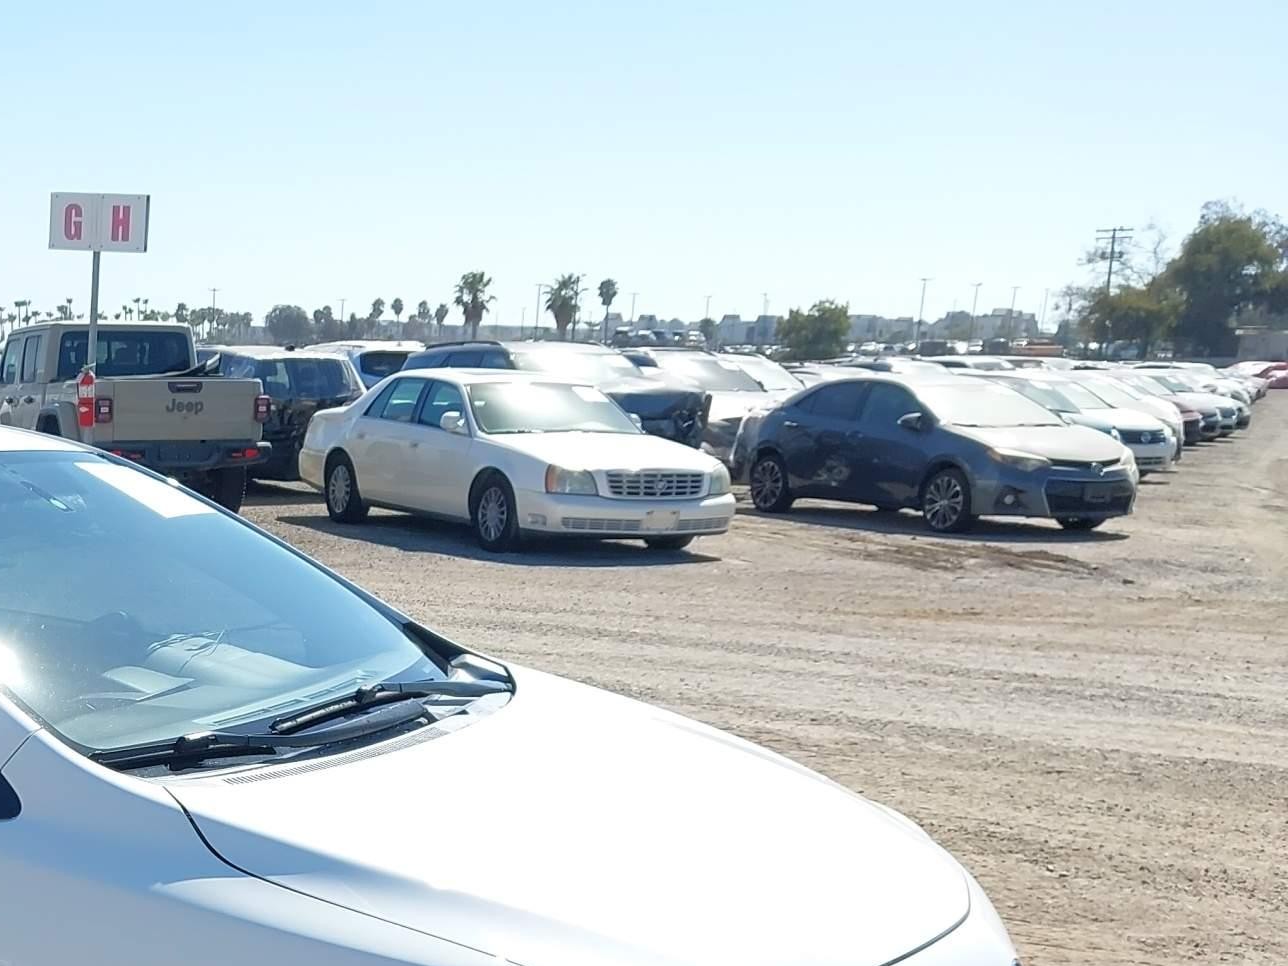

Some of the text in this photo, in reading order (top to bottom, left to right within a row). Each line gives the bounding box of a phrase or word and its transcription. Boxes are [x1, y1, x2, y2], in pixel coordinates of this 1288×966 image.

[64, 203, 131, 242] G H
[165, 398, 204, 415] Jeep
